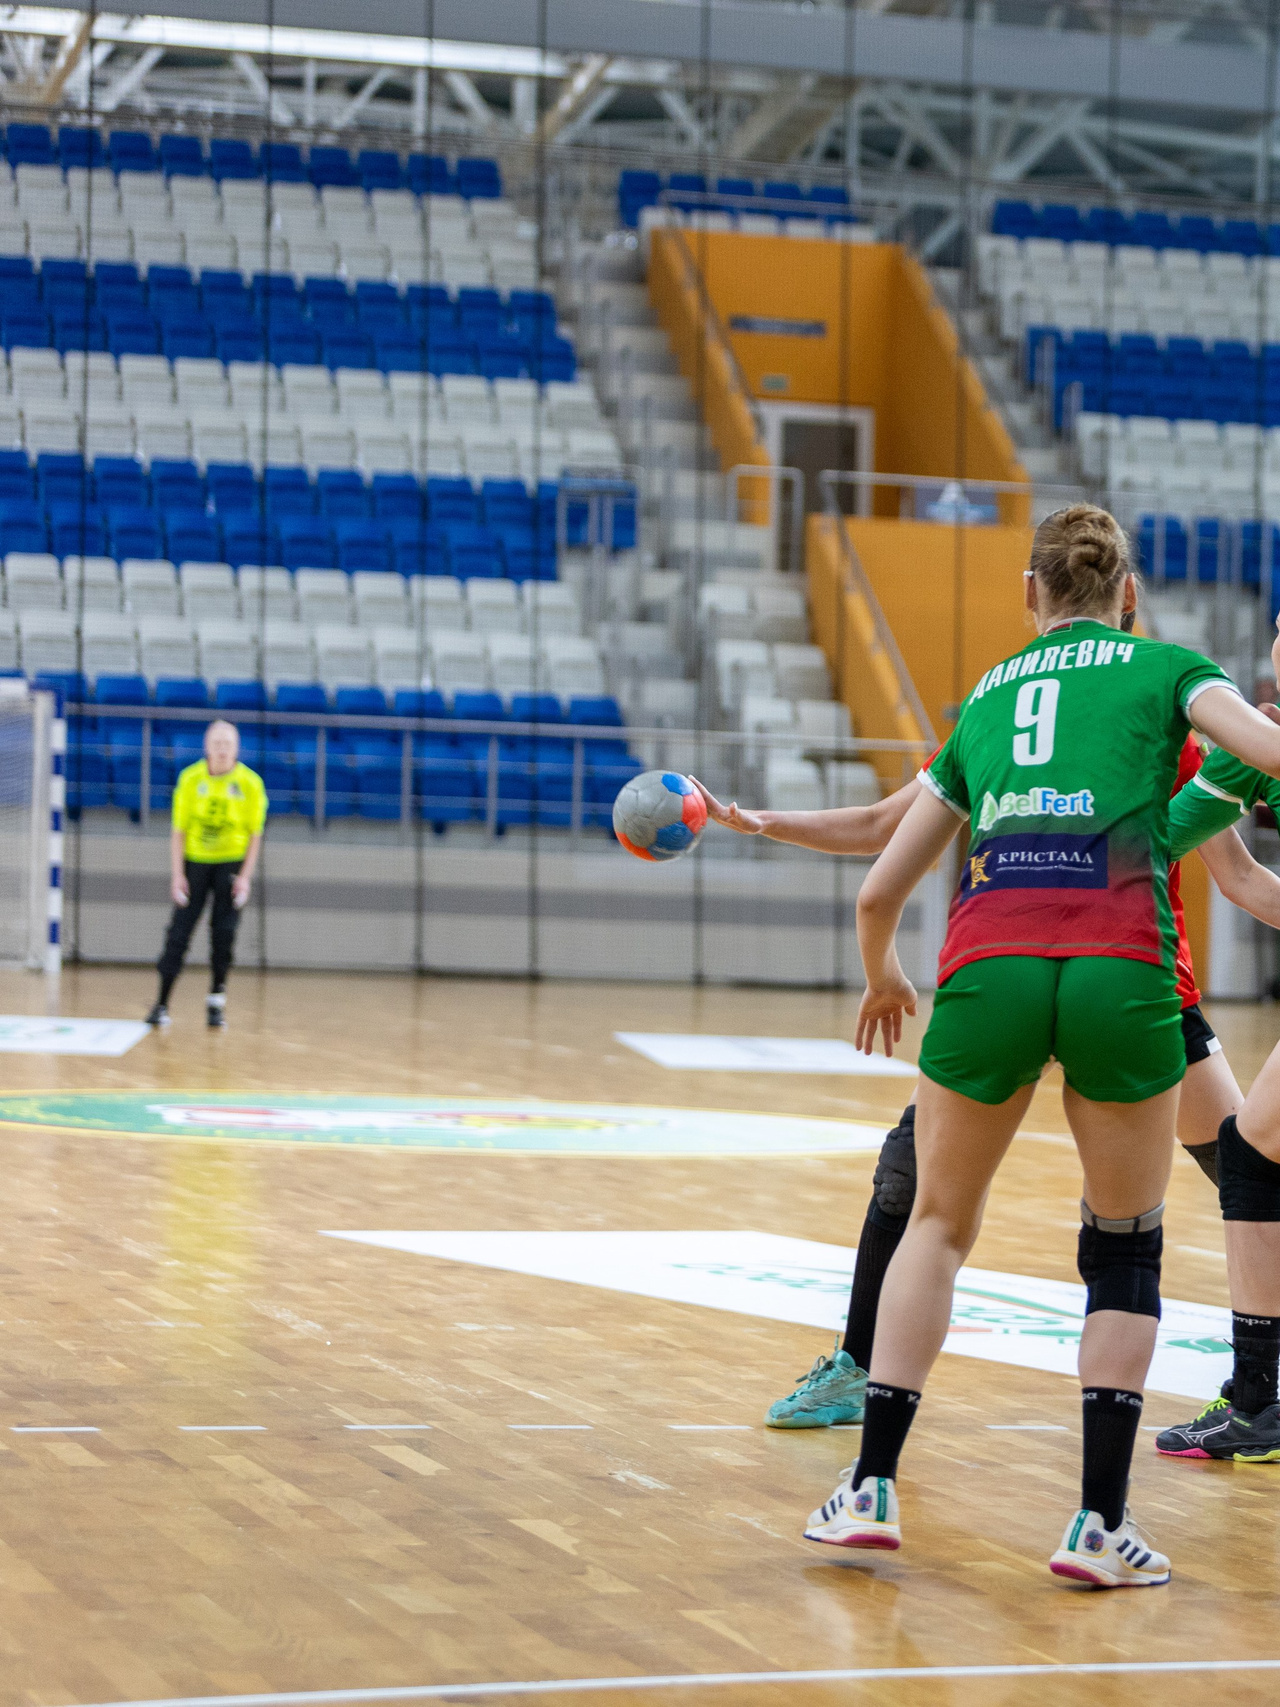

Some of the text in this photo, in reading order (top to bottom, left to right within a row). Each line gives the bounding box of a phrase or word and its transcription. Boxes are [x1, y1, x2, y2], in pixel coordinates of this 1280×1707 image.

[968, 639, 1135, 706] ДАНИЛЕВИЧ
[1013, 678, 1060, 766] 9
[1000, 789, 1092, 815] BelFert
[997, 850, 1094, 864] КРИСТАЛЛ
